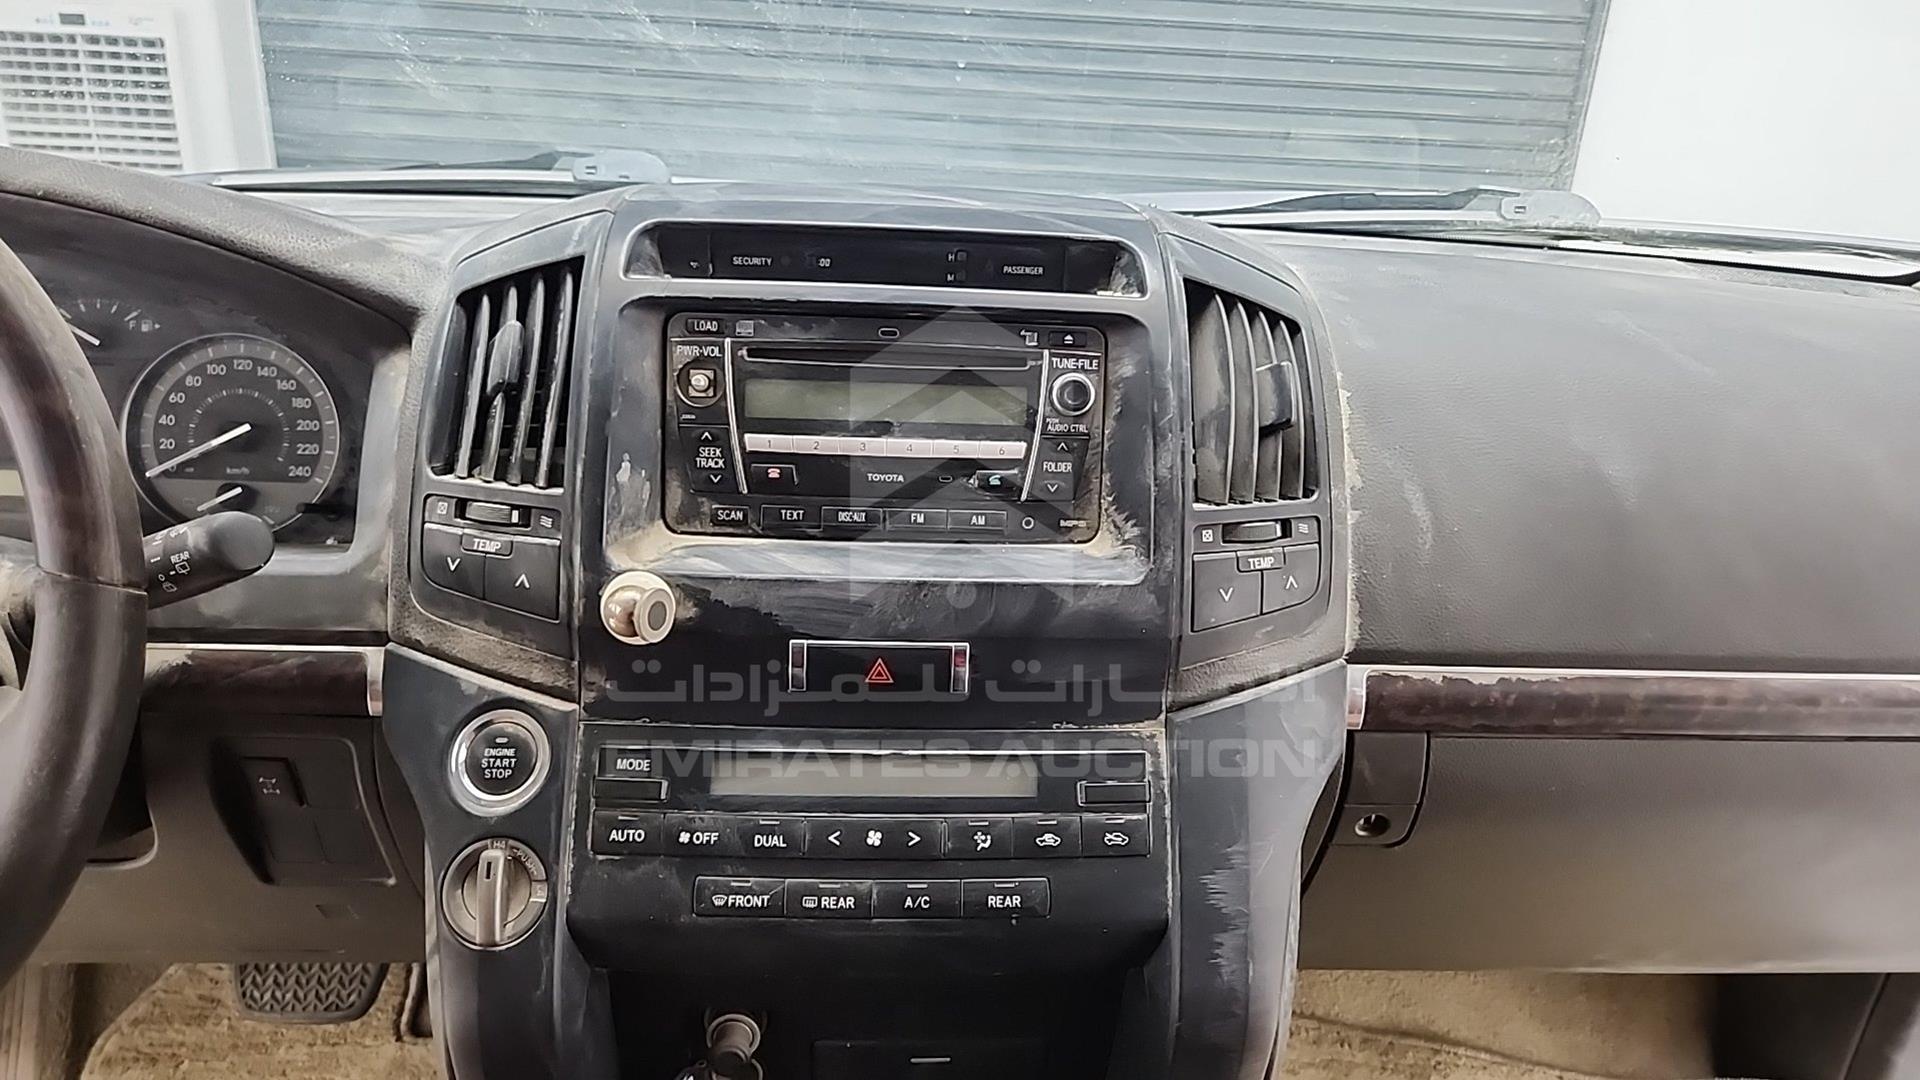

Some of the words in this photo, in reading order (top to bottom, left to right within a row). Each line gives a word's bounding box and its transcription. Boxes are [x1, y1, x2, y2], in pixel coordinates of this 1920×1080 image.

[732, 256, 772, 266] SECURITY
[947, 253, 955, 262] H
[1003, 266, 1043, 275] PASSENGER
[947, 274, 955, 282] M
[129, 320, 136, 331] F
[694, 320, 718, 331] LOAD
[207, 364, 226, 375] 100
[233, 360, 252, 370] 120
[257, 366, 277, 377] 140
[185, 376, 201, 387] 80
[276, 379, 296, 390] 160
[169, 392, 185, 403] 60
[292, 397, 311, 408] 180
[158, 415, 175, 425] 40
[296, 420, 319, 431] 200
[1047, 424, 1068, 432] AUDIO
[1070, 424, 1088, 432] CTRL
[159, 438, 175, 449] 20
[297, 443, 319, 454] 220
[767, 440, 771, 448] 1
[813, 441, 820, 450] 2
[860, 443, 866, 452] 3
[906, 443, 913, 452] 4
[699, 447, 721, 458] SEEK
[953, 445, 959, 454] 5
[999, 447, 1005, 455] 6
[695, 458, 725, 469] TRACK
[1043, 461, 1072, 473] FOLDER
[288, 466, 311, 477] 240
[867, 473, 904, 482] TOYOTA
[717, 510, 744, 521] SCAN
[780, 510, 804, 521] TEXT
[911, 512, 924, 524] FM
[970, 515, 985, 525] AM
[472, 538, 501, 551] TEMP
[170, 551, 190, 565] REAR
[1248, 557, 1274, 569] TEMP
[484, 748, 516, 757] ENGINE
[481, 758, 517, 768] START
[616, 758, 651, 772] MODE
[484, 769, 513, 779] STOP
[608, 829, 645, 842] AUTO
[692, 832, 718, 845] OFF
[753, 834, 787, 848] DUAL
[493, 840, 506, 849] H4
[727, 895, 770, 908] FRONT
[821, 896, 855, 909] REAR
[904, 896, 931, 909] A/C
[987, 895, 1021, 909] REAR
